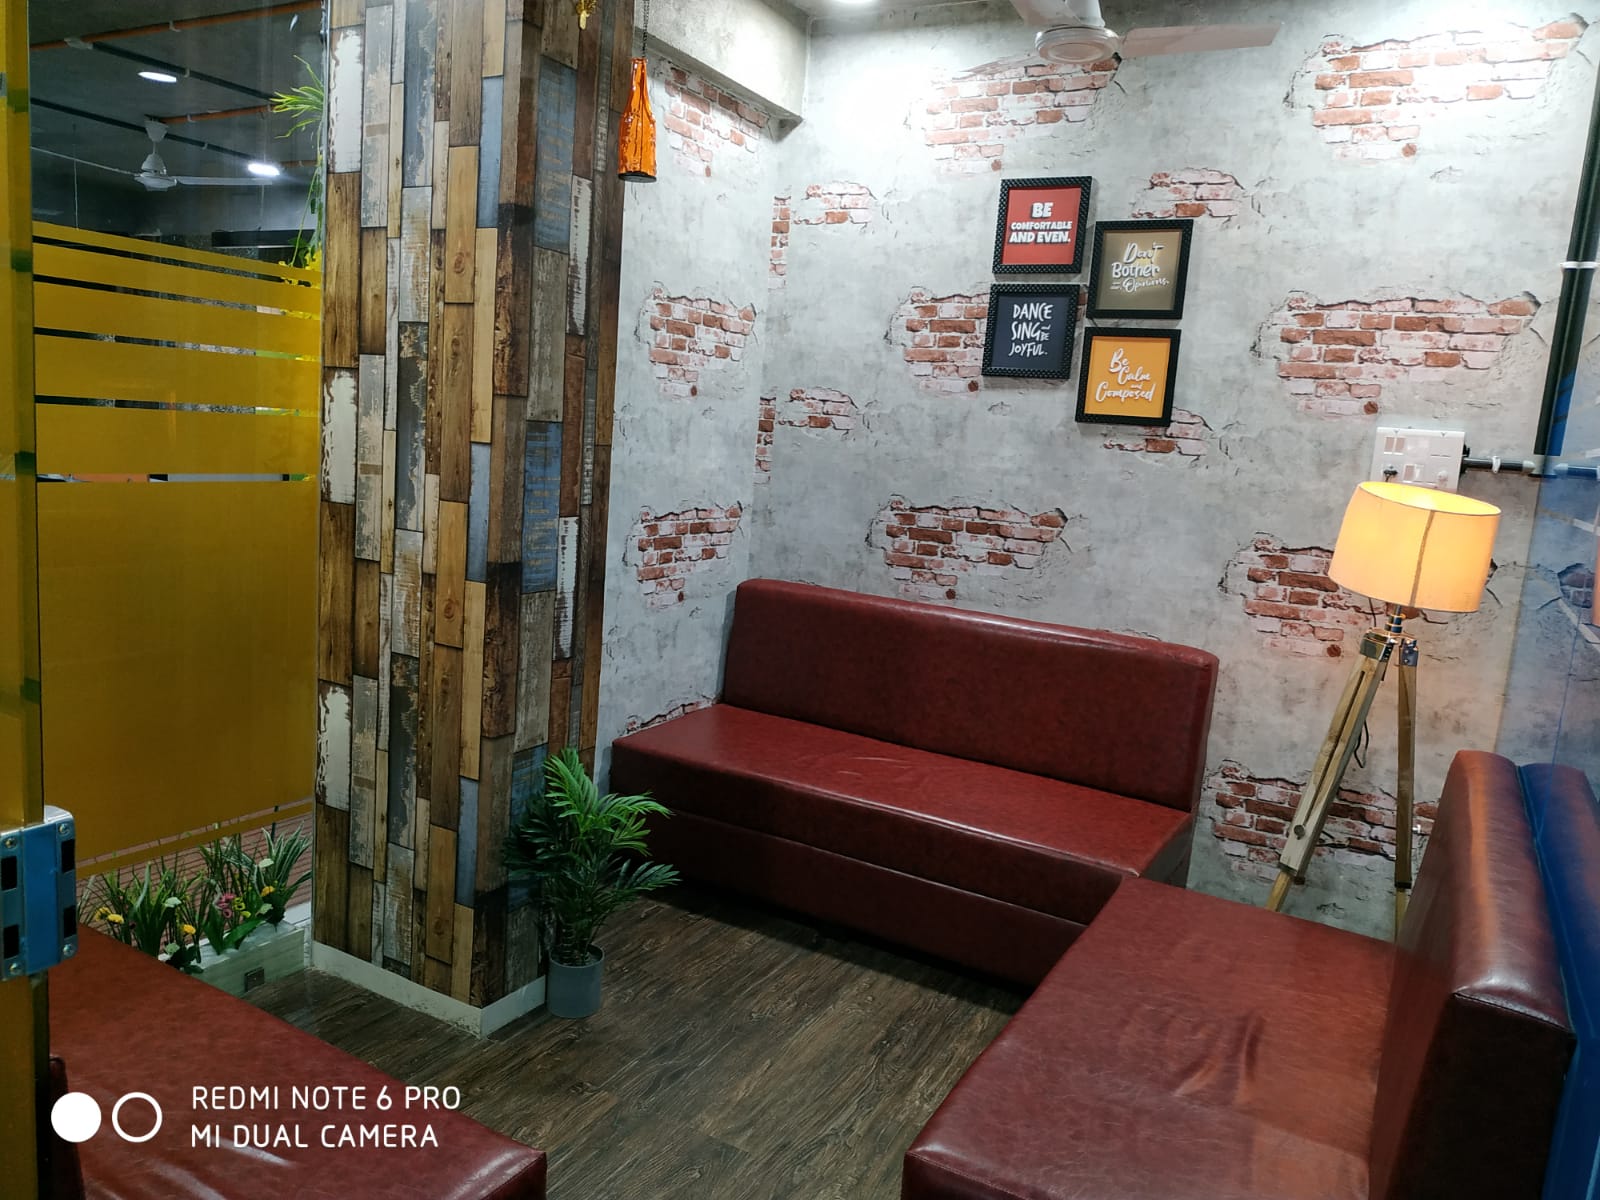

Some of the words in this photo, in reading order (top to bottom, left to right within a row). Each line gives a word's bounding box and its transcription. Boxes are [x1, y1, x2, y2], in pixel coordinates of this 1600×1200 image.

[1032, 202, 1053, 218] BE
[1011, 221, 1072, 230] COMFORTABLE
[1009, 231, 1035, 243] AND
[1036, 231, 1071, 242] EVEN.
[1112, 262, 1160, 278] Bother
[1013, 303, 1053, 321] DANCE
[1011, 321, 1041, 340] SING
[1008, 342, 1048, 357] JOYFUL.
[1109, 348, 1129, 372] Be
[1118, 367, 1151, 384] Calm
[1096, 382, 1156, 402] Composed
